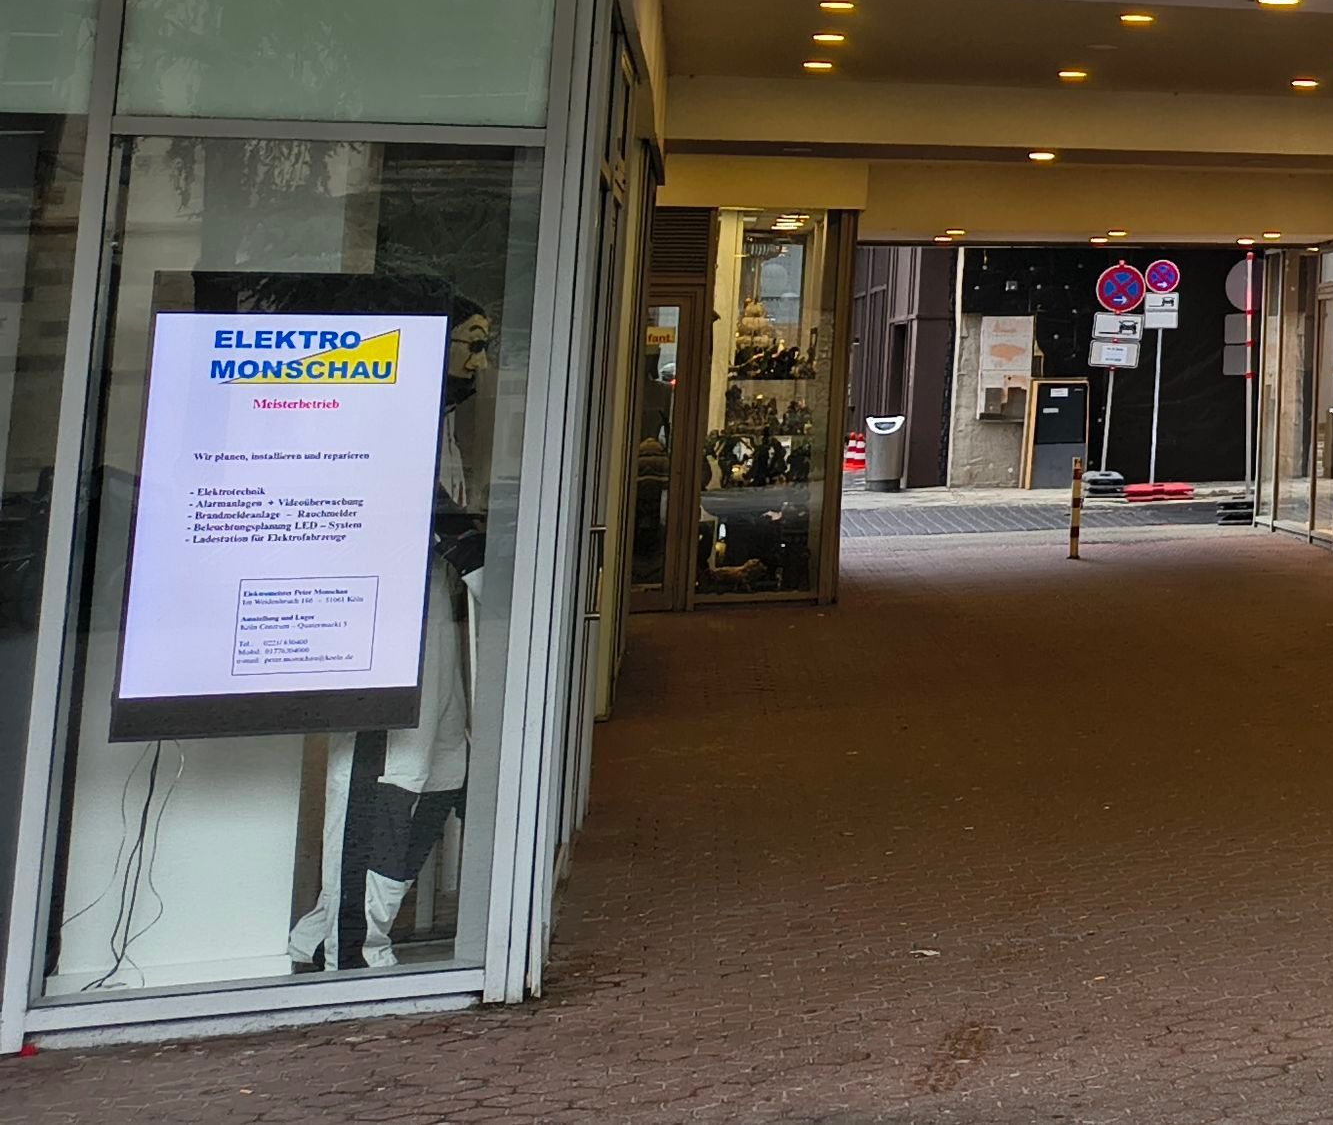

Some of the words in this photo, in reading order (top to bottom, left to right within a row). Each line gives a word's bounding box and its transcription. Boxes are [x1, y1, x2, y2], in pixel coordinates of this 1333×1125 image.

[214, 330, 361, 350] ELEKTRO
[210, 359, 392, 379] MONSCHAU
[253, 398, 340, 410] Meisterbetrieb
[194, 452, 213, 461] Wir
[214, 452, 249, 463] planen,
[251, 452, 302, 460] installieren
[304, 452, 321, 460] und
[323, 451, 370, 462] reparieren
[197, 487, 266, 496] Elektrotechnik
[195, 499, 262, 509] Alarmanlagen
[278, 497, 364, 508] Videoüberwachung
[195, 510, 280, 521] Brandmeldeanlage
[297, 510, 357, 518] Rauchmelder
[294, 521, 318, 530] LED
[328, 520, 362, 530] System
[192, 535, 248, 544] Ladestation
[251, 534, 264, 543] für
[267, 533, 347, 543] Elektrofahrzeuge
